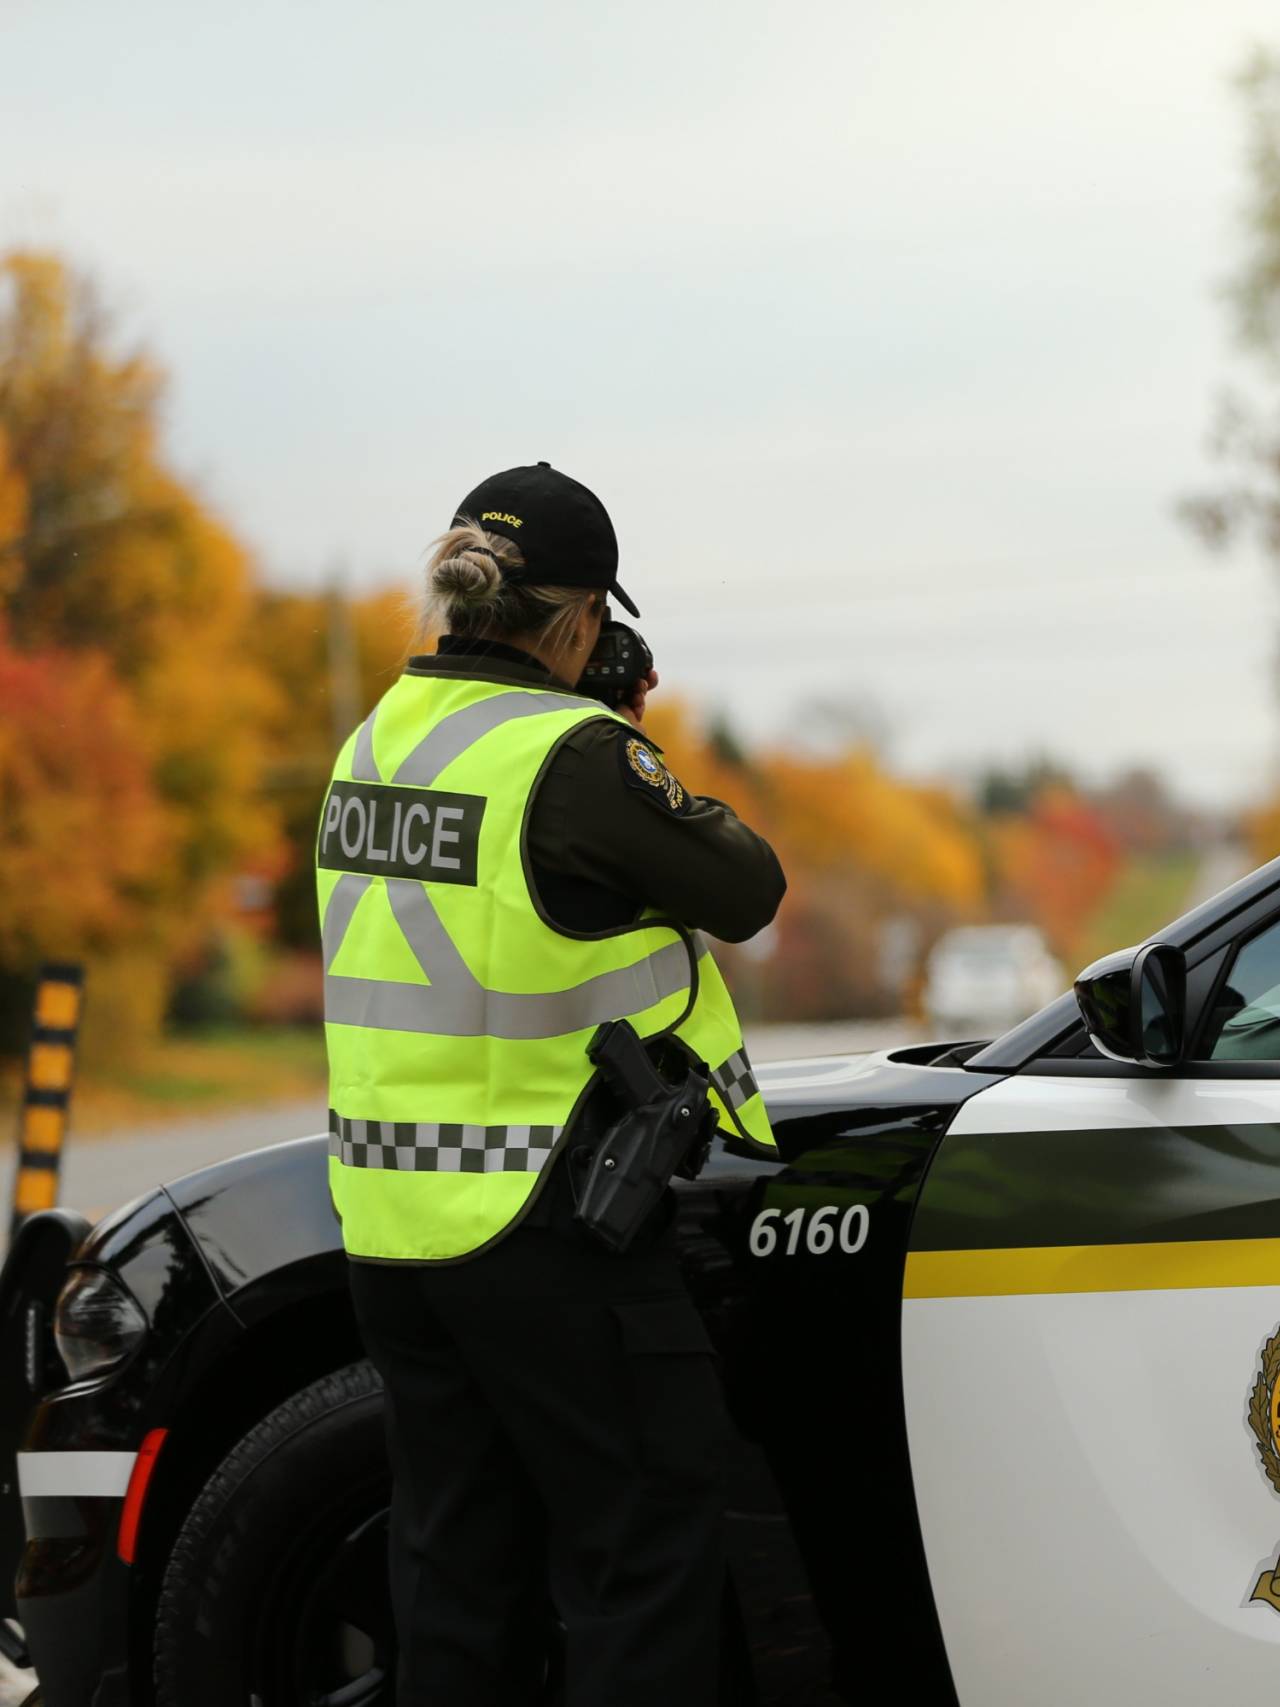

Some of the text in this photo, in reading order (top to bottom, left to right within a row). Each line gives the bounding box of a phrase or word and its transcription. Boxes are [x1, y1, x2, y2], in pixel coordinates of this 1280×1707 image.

[481, 511, 524, 529] POLICE
[322, 794, 465, 870] POLICE
[749, 1204, 870, 1257] 6160
